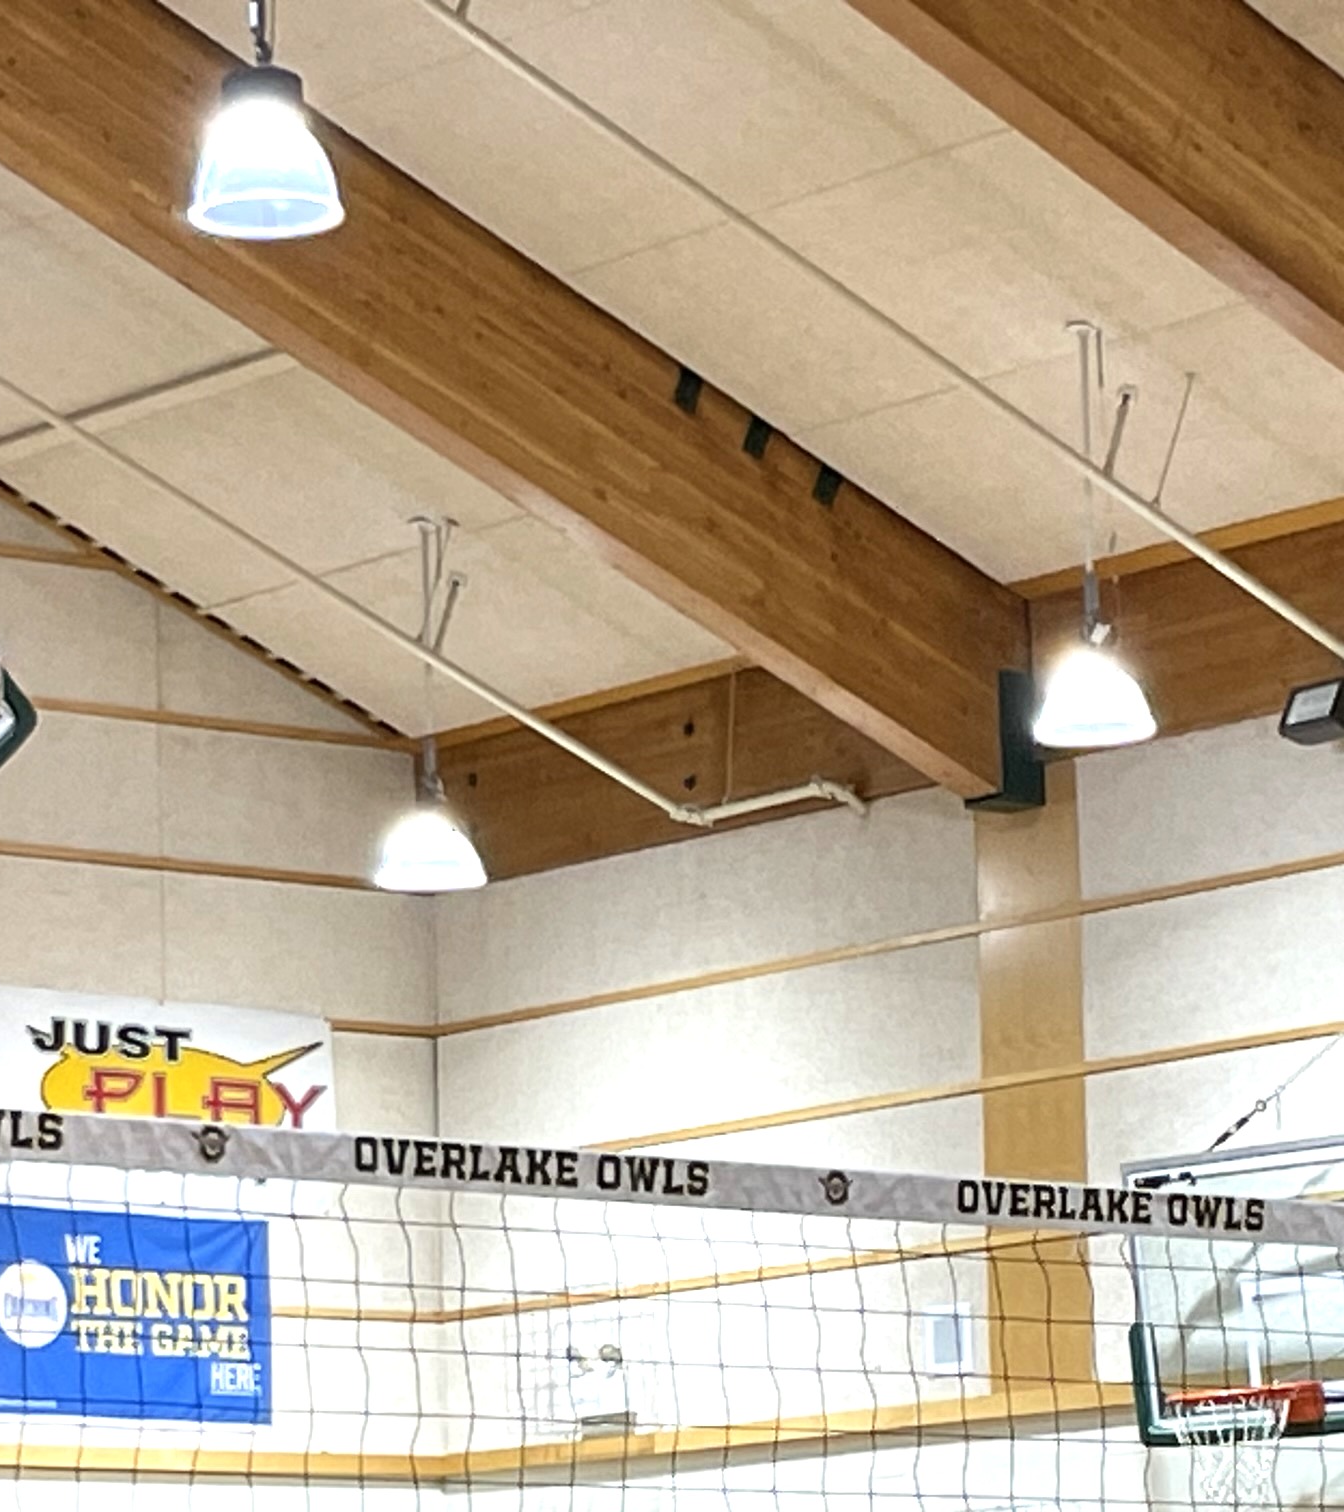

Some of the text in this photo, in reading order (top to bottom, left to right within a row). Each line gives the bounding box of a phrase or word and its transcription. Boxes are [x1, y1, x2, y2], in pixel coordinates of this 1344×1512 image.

[26, 1016, 192, 1062] JUST
[84, 1067, 327, 1128] PLAY
[354, 1135, 709, 1197] OVERLAKE OWLS
[957, 1179, 1265, 1232] OVERLAKE OWLS
[64, 1233, 102, 1265] WE
[71, 1266, 249, 1322] HONOR
[71, 1320, 252, 1362] THE GAME
[210, 1361, 262, 1395] HERE
